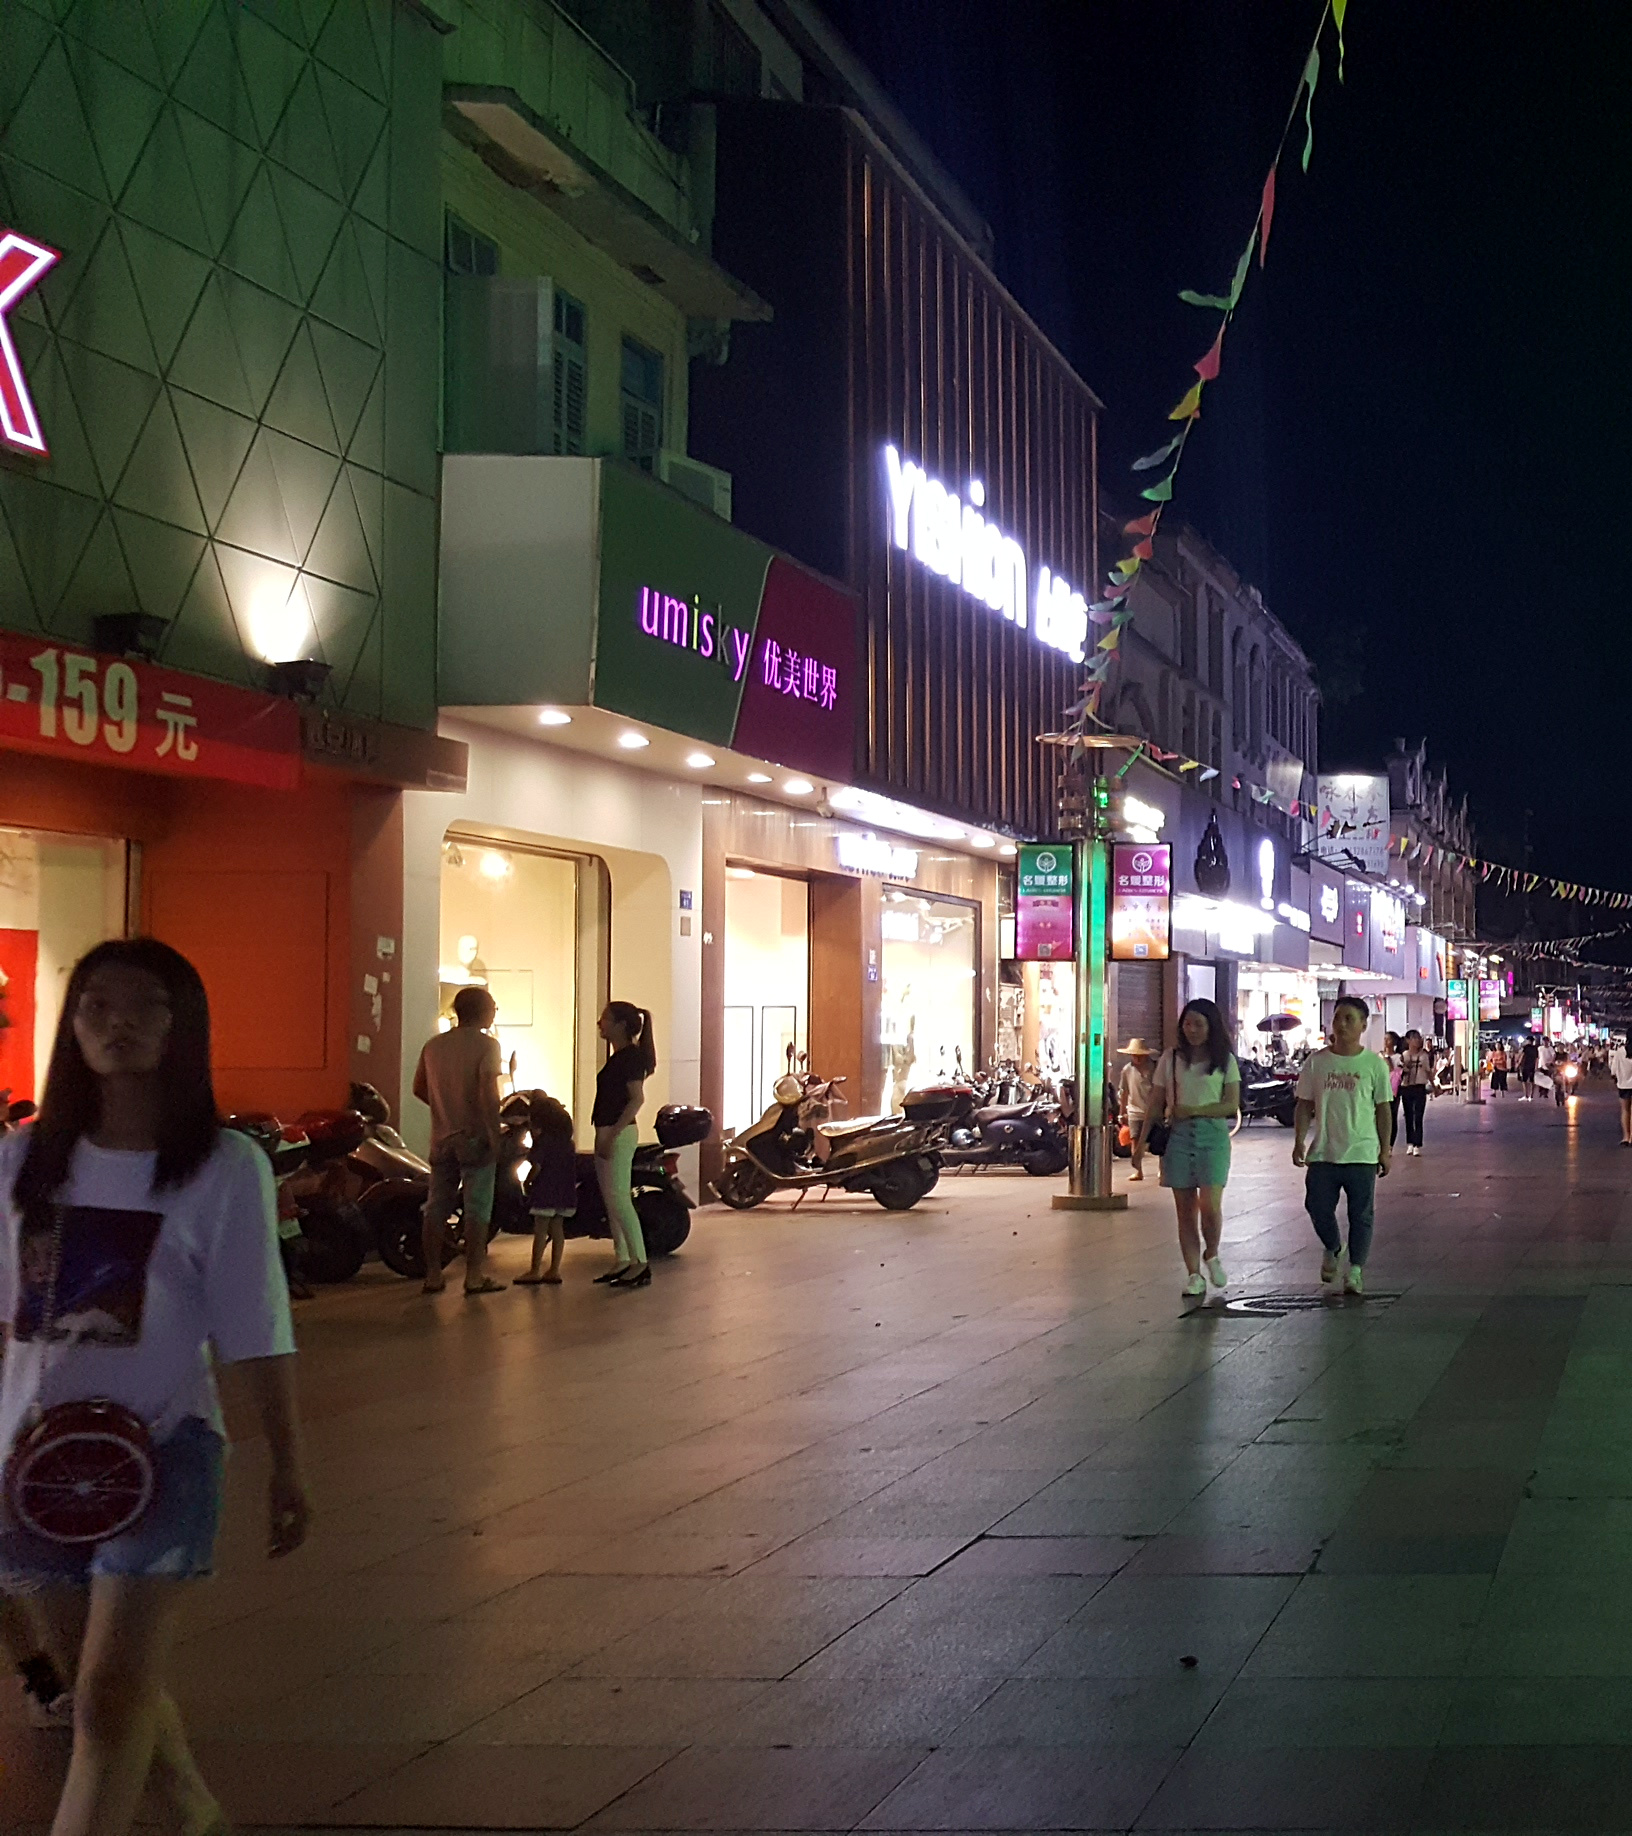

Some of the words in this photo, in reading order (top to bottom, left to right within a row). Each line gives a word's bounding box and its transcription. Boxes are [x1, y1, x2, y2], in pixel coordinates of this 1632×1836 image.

[641, 586, 750, 682] umisky
[763, 638, 837, 711] 优美世界
